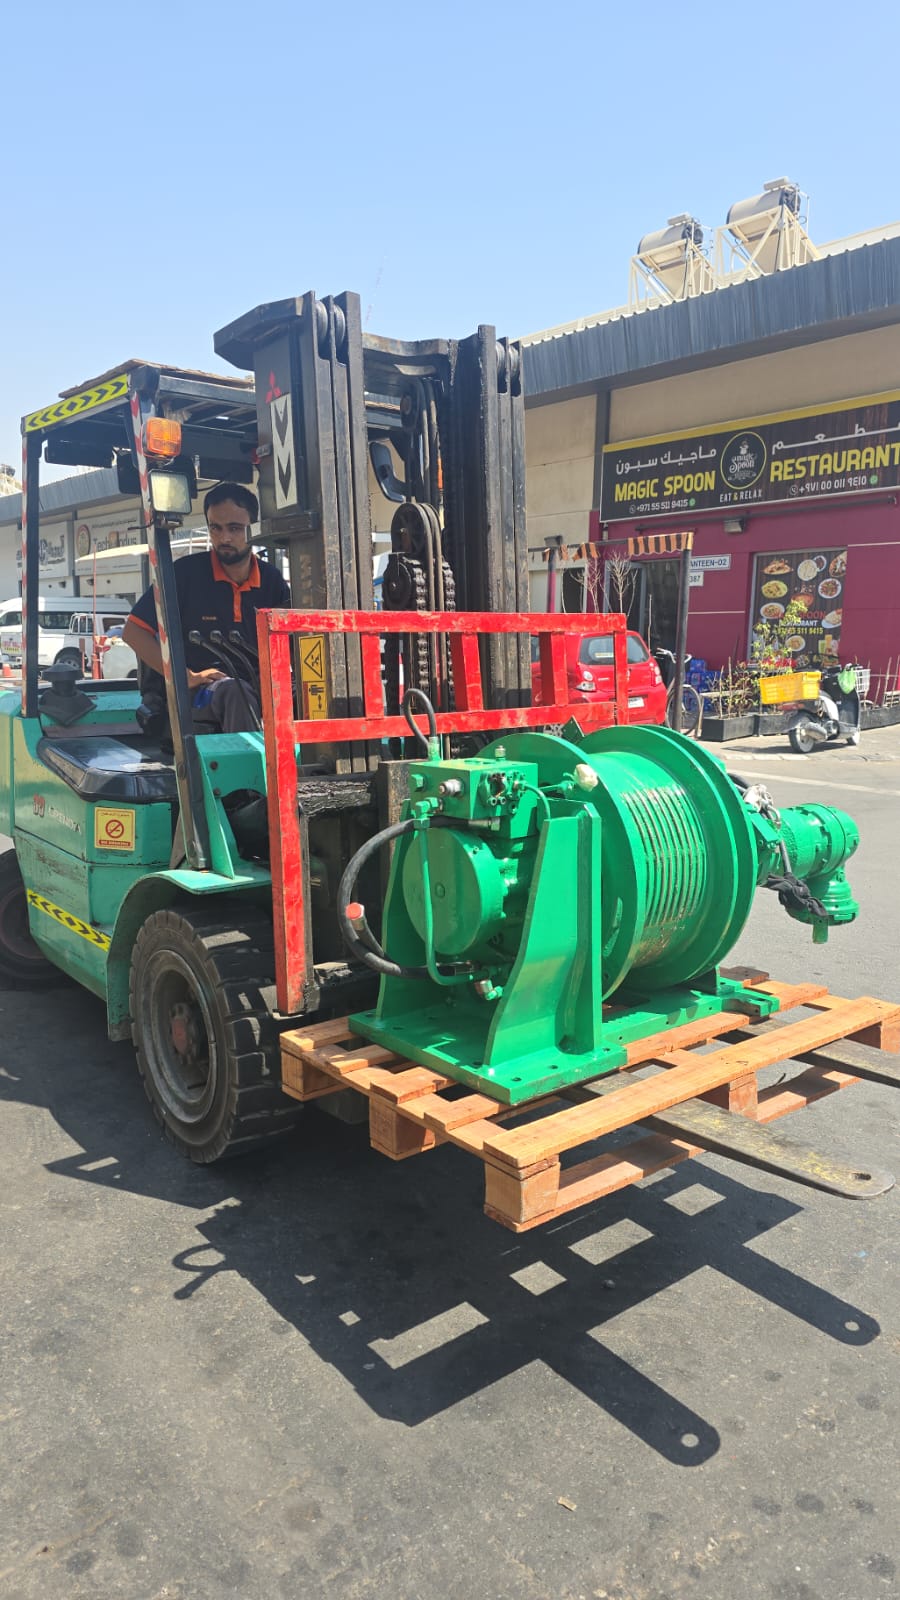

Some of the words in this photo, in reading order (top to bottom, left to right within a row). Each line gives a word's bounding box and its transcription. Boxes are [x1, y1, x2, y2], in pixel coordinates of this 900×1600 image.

[771, 422, 900, 456] طعم
[616, 457, 658, 475] سبون
[660, 446, 717, 466] ماجيك
[769, 442, 900, 482] RESTAURANT
[614, 478, 659, 502] MAGIC
[663, 470, 716, 497] SPOON
[719, 492, 732, 501] EAT
[733, 491, 738, 501] &
[739, 489, 763, 500] RELAX
[636, 504, 650, 512] +971
[651, 503, 660, 511] 55
[662, 501, 671, 510] 511
